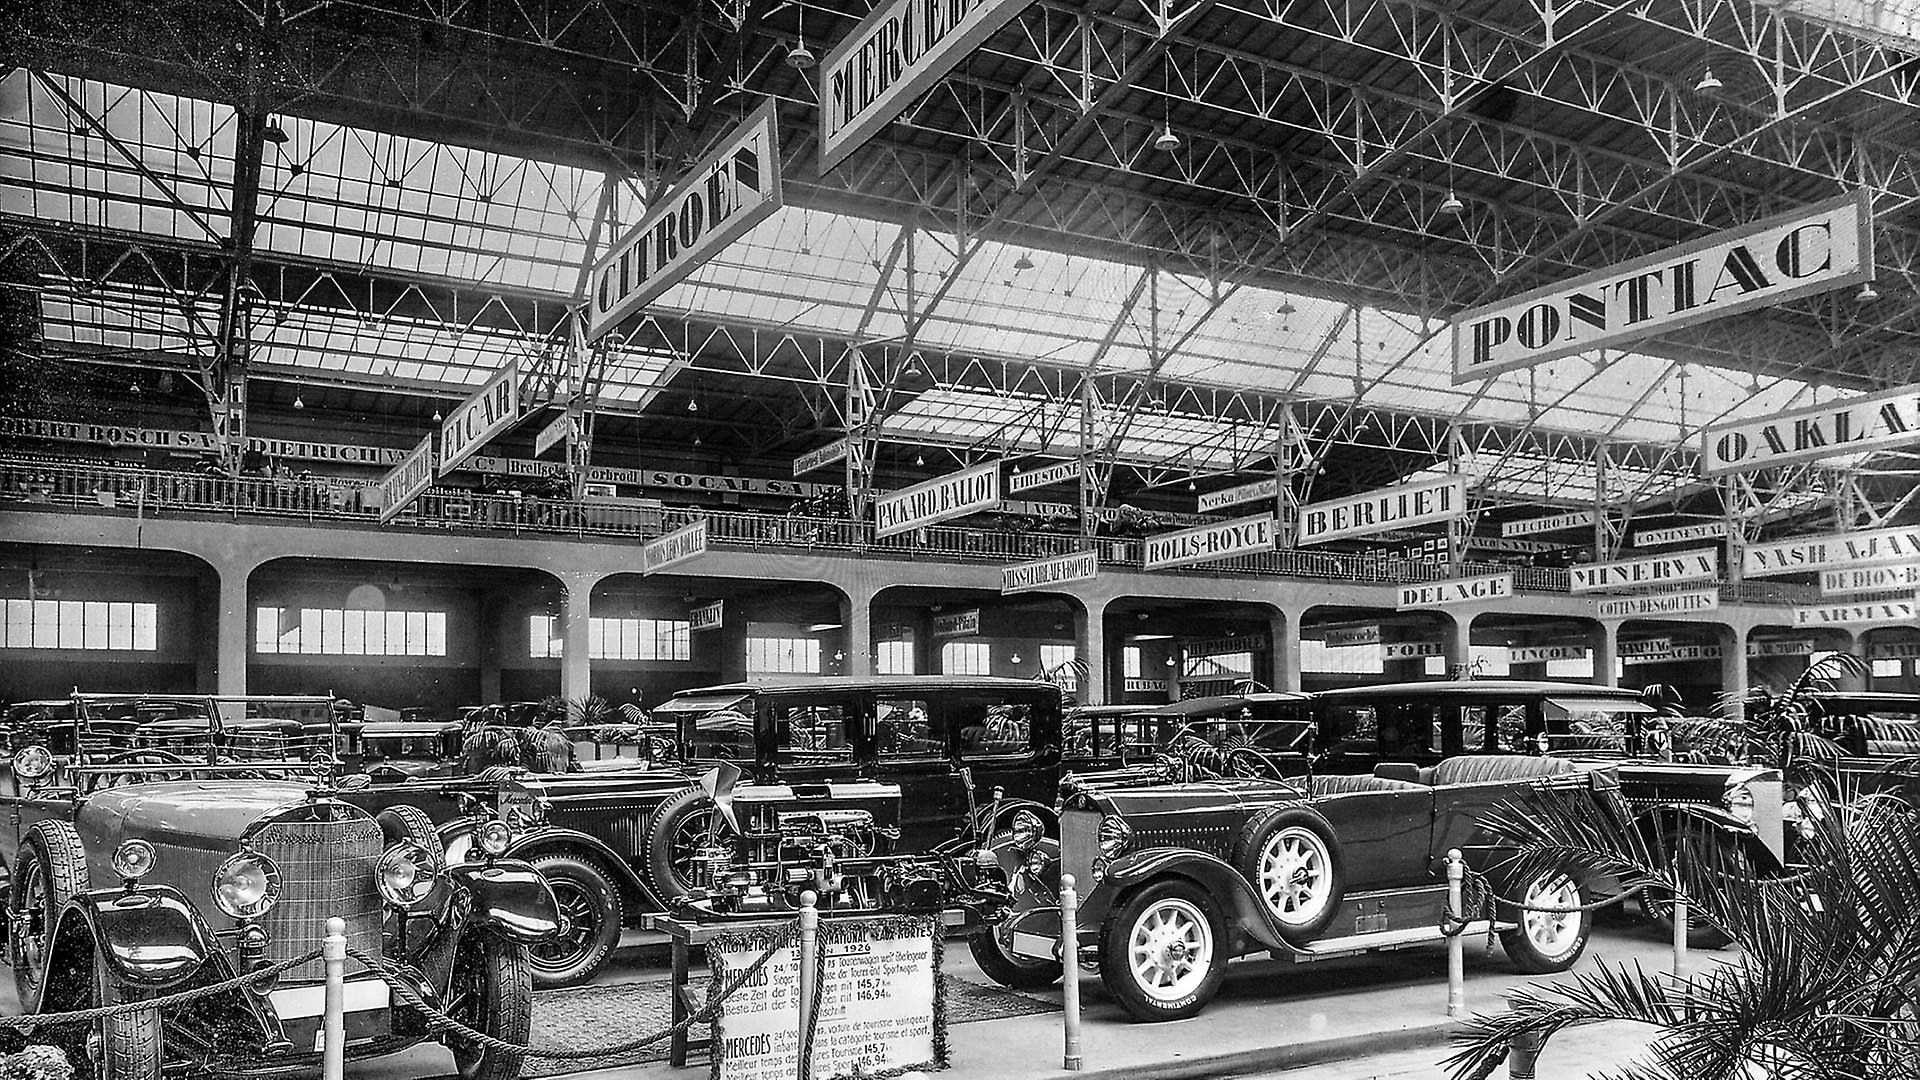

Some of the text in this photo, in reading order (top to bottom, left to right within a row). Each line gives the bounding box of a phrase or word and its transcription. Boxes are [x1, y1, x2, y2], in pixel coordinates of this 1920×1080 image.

[599, 133, 762, 313] CITROËN
[1470, 221, 1831, 365] PONTIAC
[443, 378, 511, 461] ELCAR
[250, 439, 377, 464] DIETRICH
[653, 473, 757, 491] SOCAL
[1013, 461, 1080, 489] FIRESTONE
[1307, 484, 1456, 535] BERLIET
[1150, 522, 1267, 563] ROLLS-ROYCE
[1574, 556, 1711, 586] MINERVA
[1403, 578, 1504, 605] DELAGE
[844, 943, 871, 953] 1926
[1143, 993, 1197, 1010] CONTINENTAL
